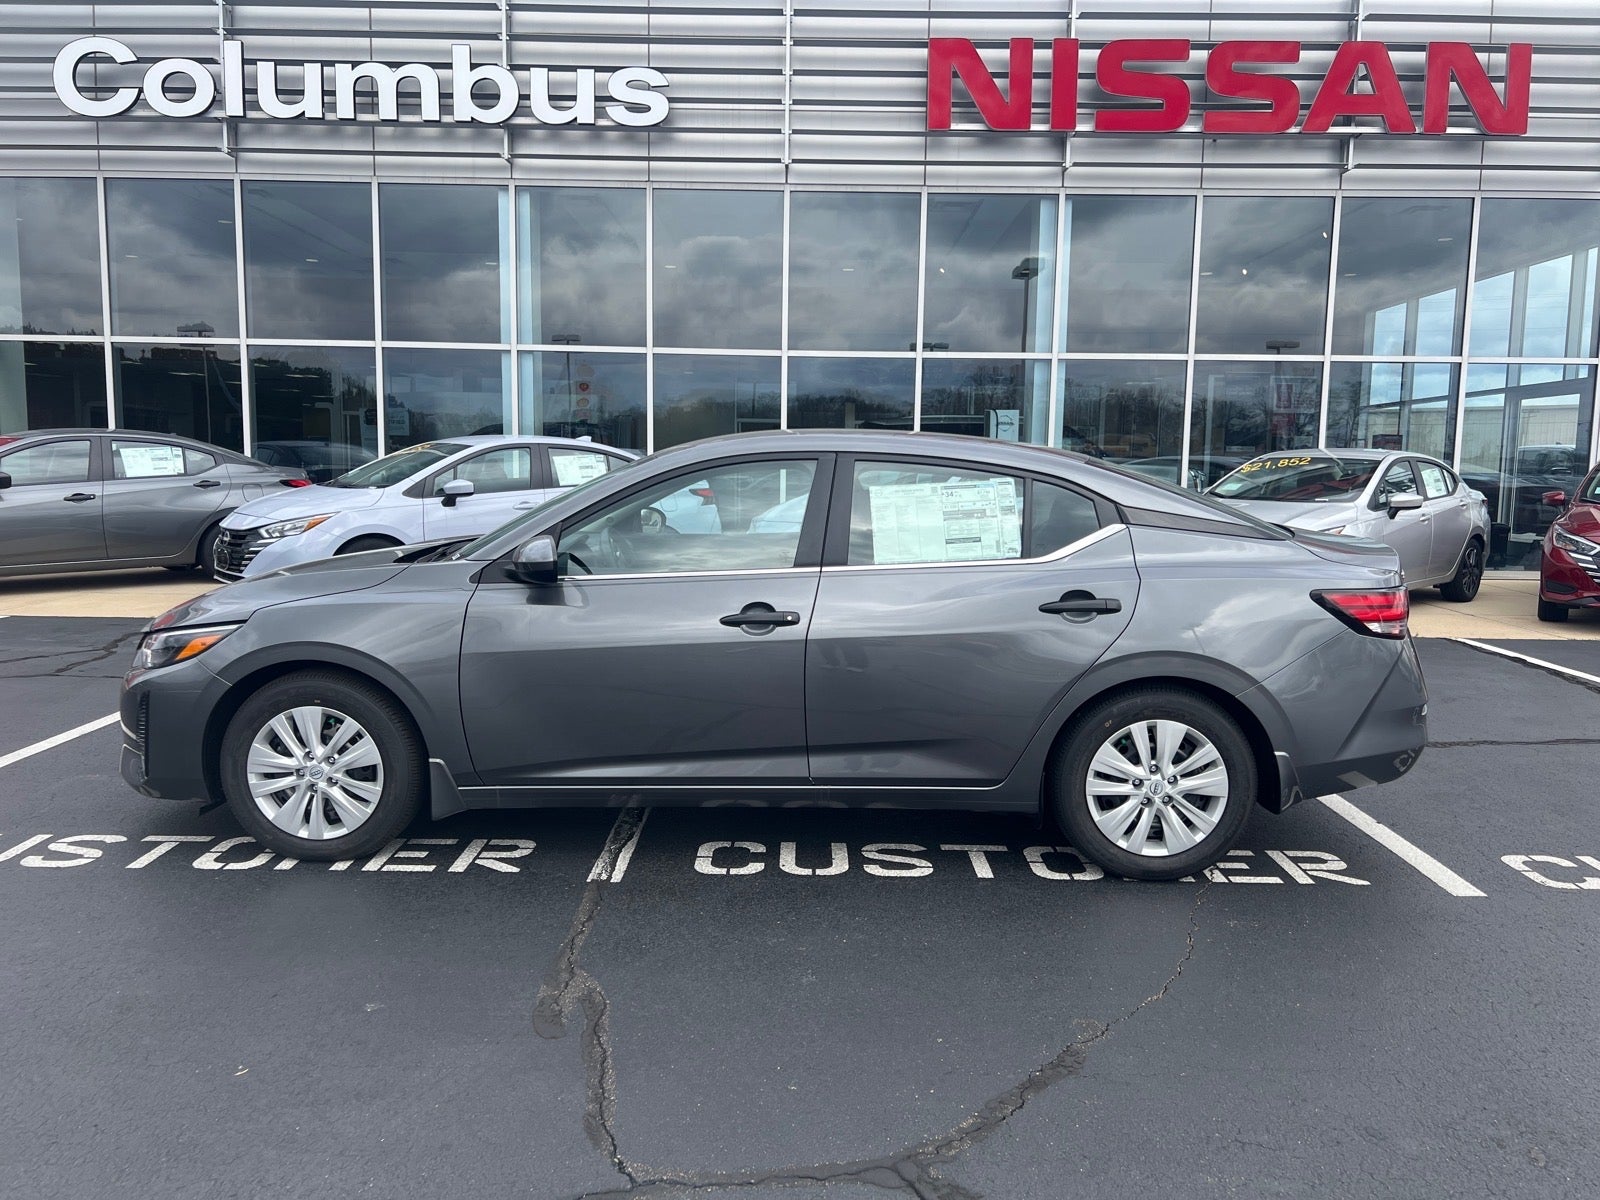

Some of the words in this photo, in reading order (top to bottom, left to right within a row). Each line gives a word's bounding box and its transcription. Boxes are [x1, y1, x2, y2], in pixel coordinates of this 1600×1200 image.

[53, 36, 670, 127] Columbus
[927, 38, 1532, 136] NISSAN
[1241, 457, 1311, 473] $21,852
[694, 841, 1372, 885] CUSTOER
